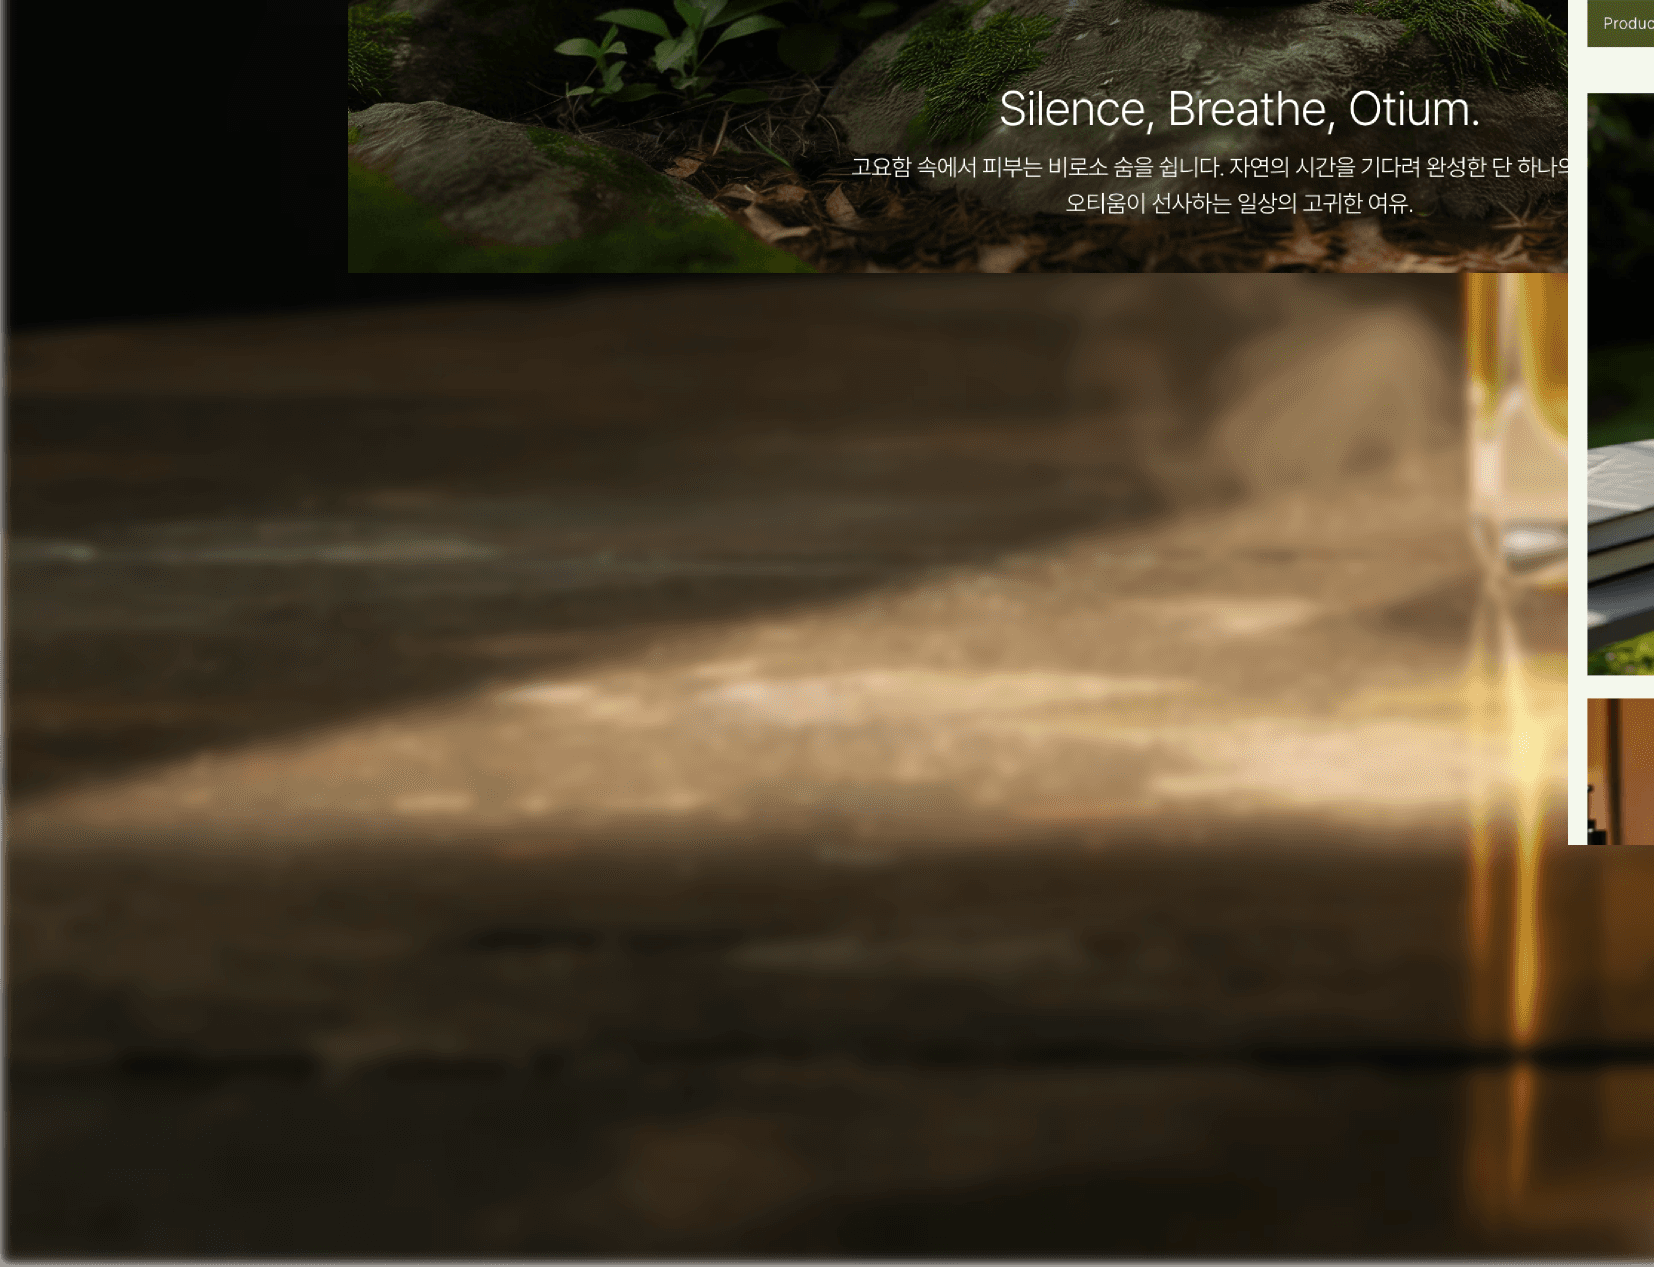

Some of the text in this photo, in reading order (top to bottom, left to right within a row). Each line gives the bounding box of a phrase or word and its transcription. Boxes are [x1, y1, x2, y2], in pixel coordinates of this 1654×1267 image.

[1000, 90, 1479, 135] Silence, Breathe, Otium.
[851, 156, 912, 178] 고요함
[917, 156, 976, 179] 속에서
[982, 156, 1043, 178] 피부는
[1049, 156, 1109, 178] 비로소
[1114, 156, 1154, 178] 숨을
[1159, 156, 1224, 178] 쉽니다.
[1230, 156, 1289, 178] 자연의
[1295, 156, 1356, 178] 시간을
[1361, 156, 1420, 178] 기다려
[1426, 156, 1488, 178] 완성한
[1492, 156, 1513, 178] 단
[1066, 192, 1413, 215] 오티움이 선사하는 일상의 고귀한 여유.
